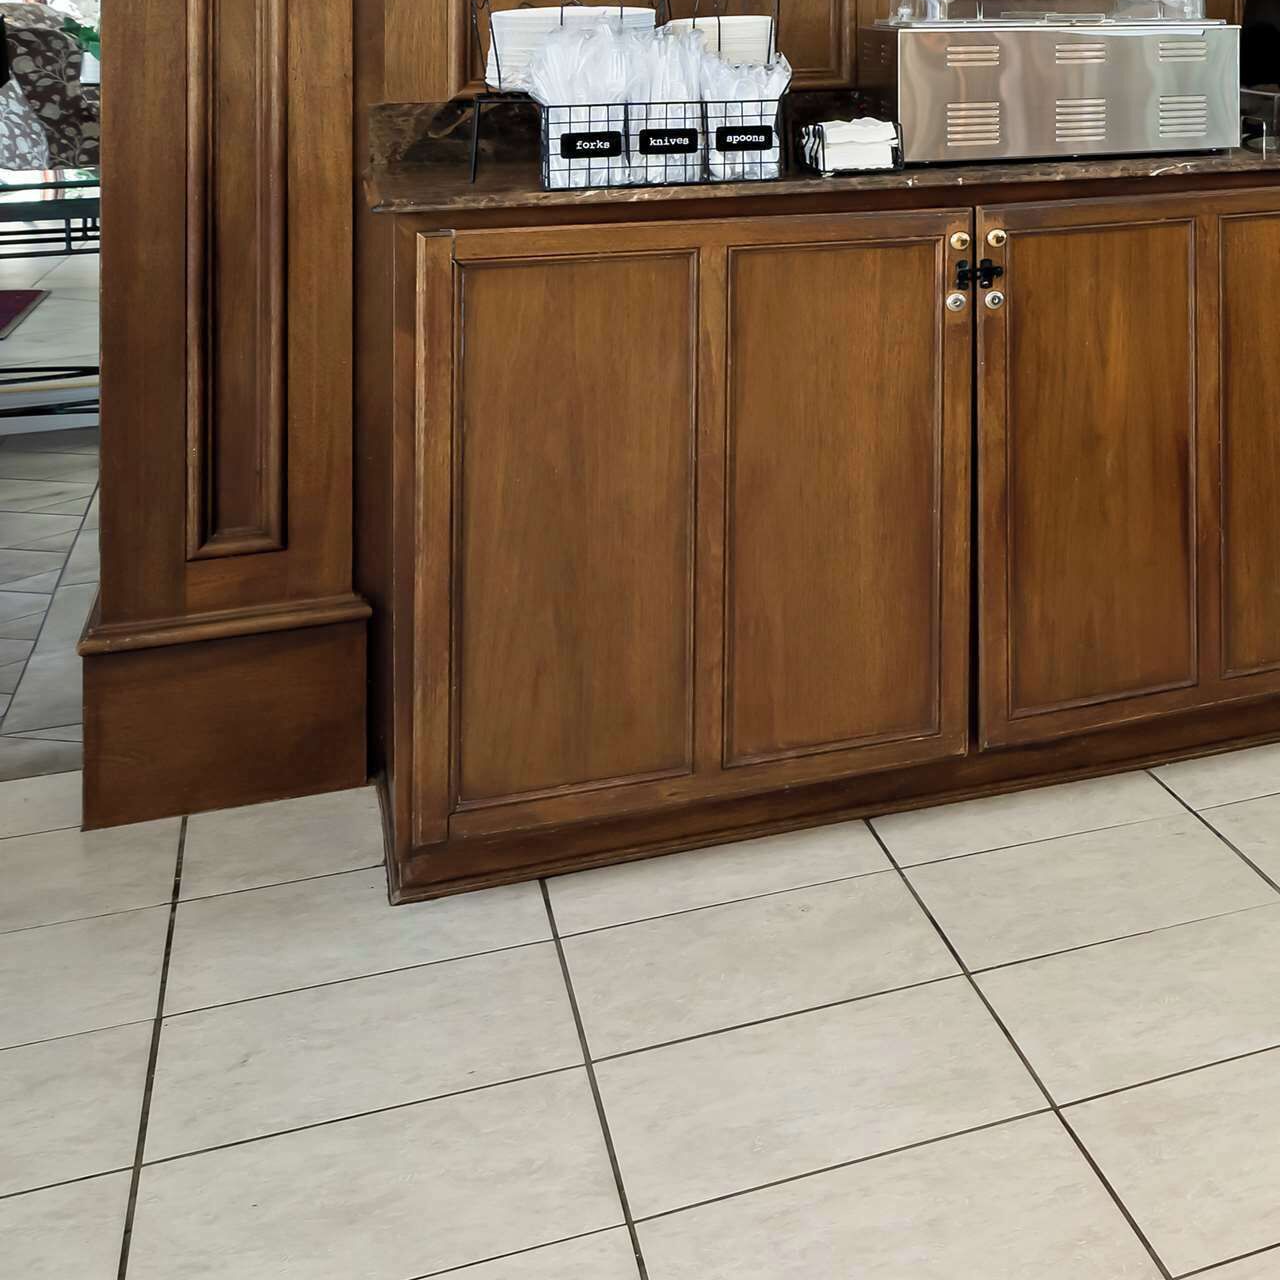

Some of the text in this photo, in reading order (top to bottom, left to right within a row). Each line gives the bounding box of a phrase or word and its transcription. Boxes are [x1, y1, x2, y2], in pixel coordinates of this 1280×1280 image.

[649, 136, 689, 146] knives
[726, 134, 765, 144] spoons
[575, 140, 611, 150] forks
